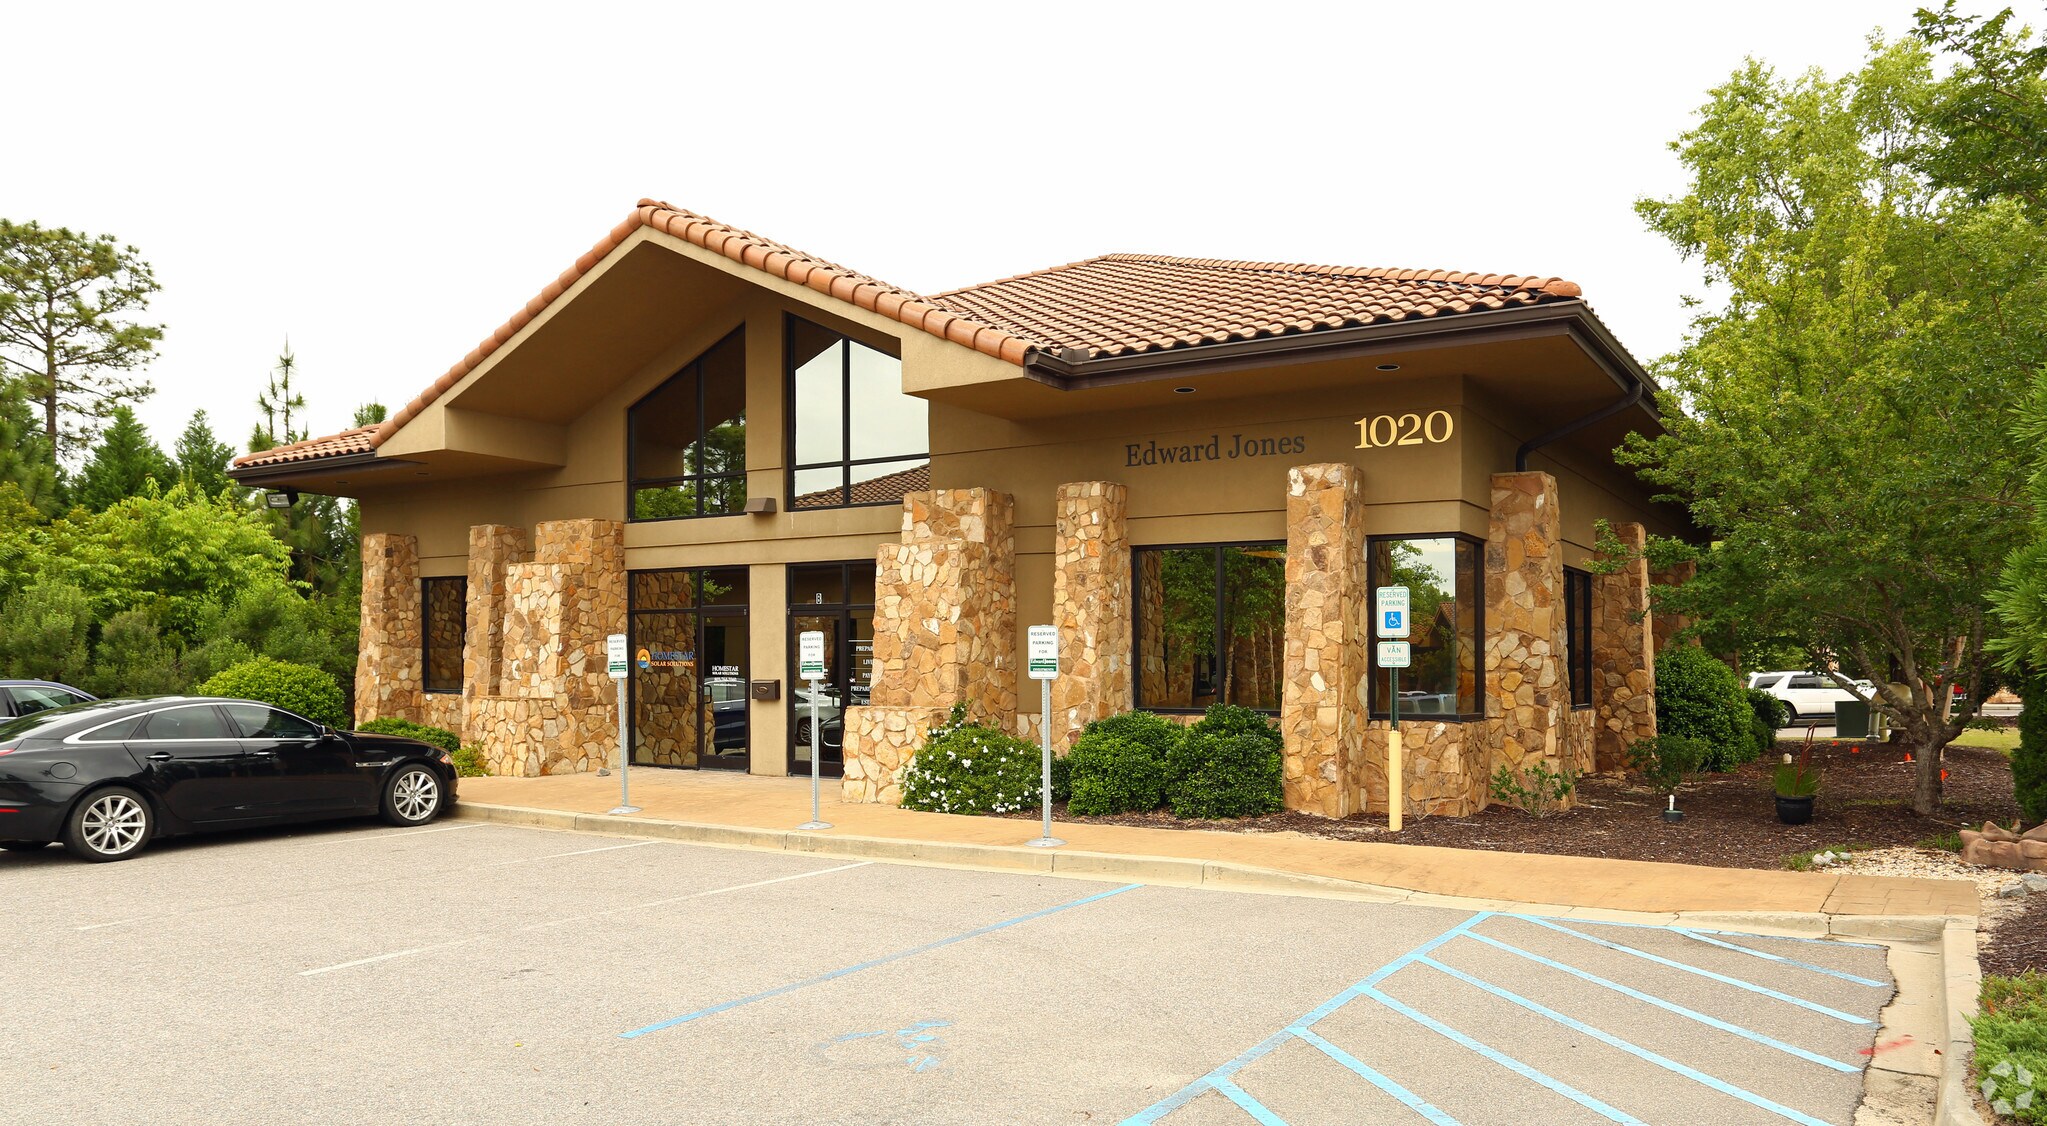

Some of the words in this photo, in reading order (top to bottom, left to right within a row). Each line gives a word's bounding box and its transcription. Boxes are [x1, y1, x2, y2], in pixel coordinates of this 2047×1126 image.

[1354, 410, 1454, 449] 1020
[1125, 435, 1219, 467] Edward
[1228, 434, 1306, 459] Jones
[651, 651, 694, 660] HOMESTAR
